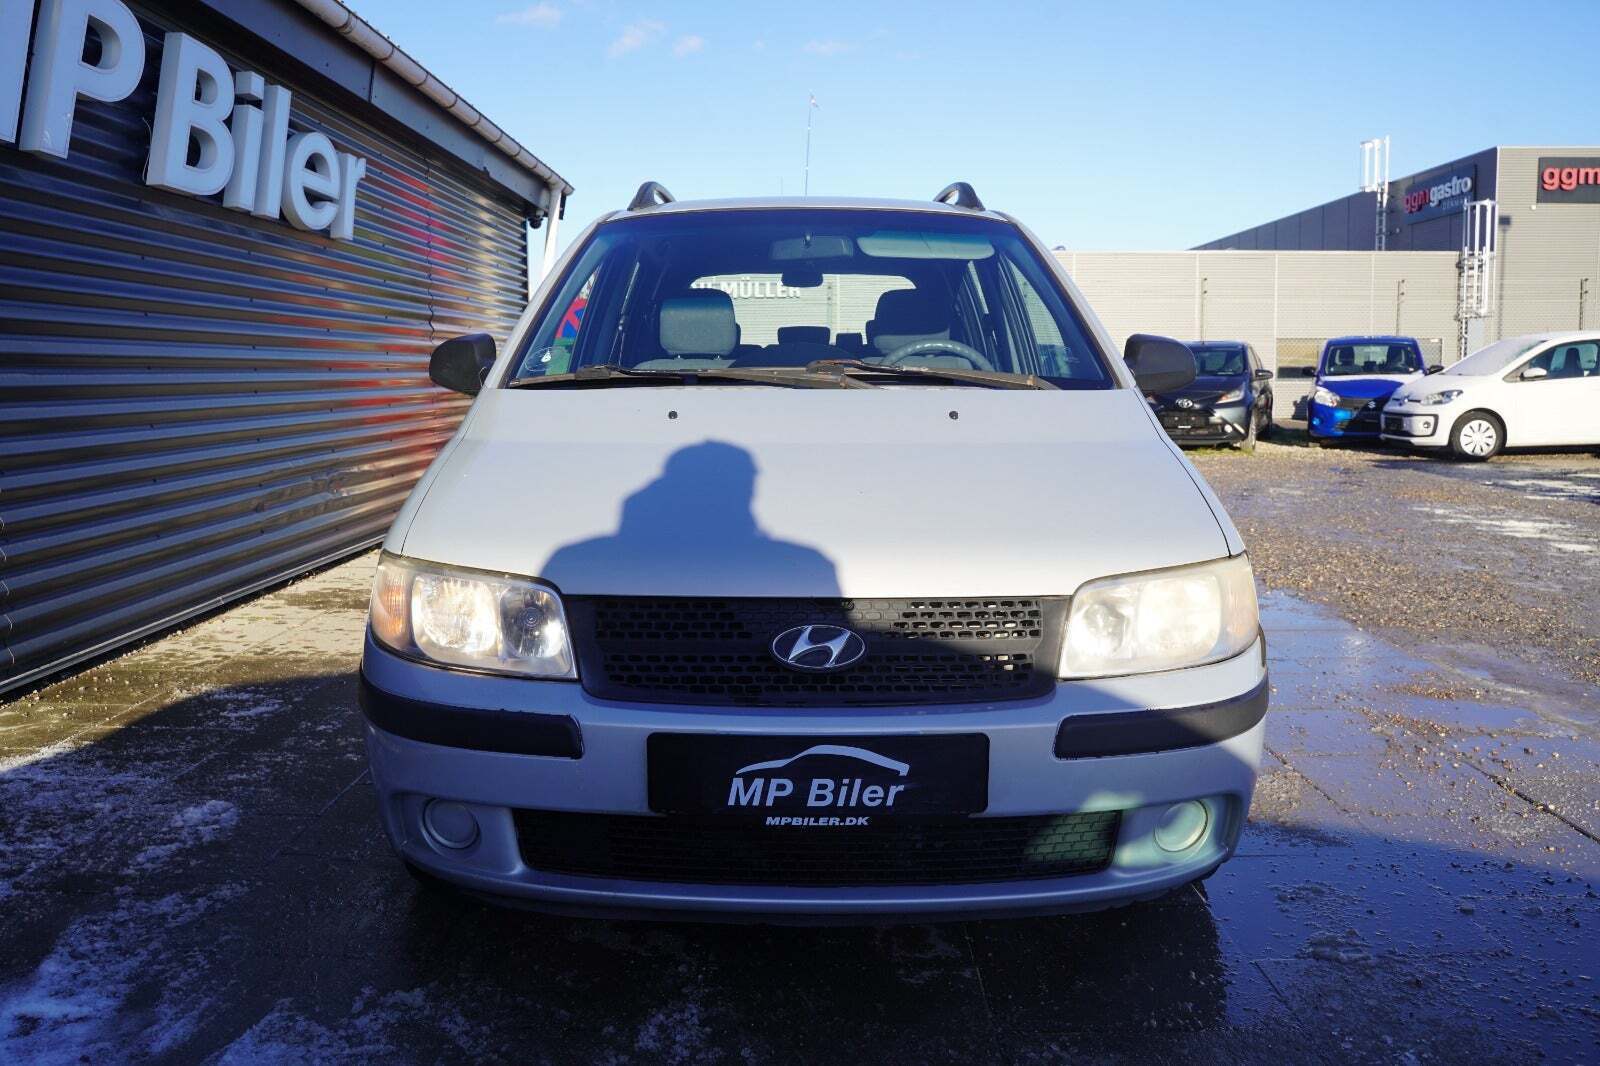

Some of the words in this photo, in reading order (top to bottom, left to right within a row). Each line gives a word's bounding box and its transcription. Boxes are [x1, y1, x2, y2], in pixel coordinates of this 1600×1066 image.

[146, 32, 366, 240] Biler
[1542, 167, 1600, 191] ggm
[727, 777, 793, 807] MP
[807, 778, 904, 807] Biler
[765, 816, 869, 826] MPBILER.DK
